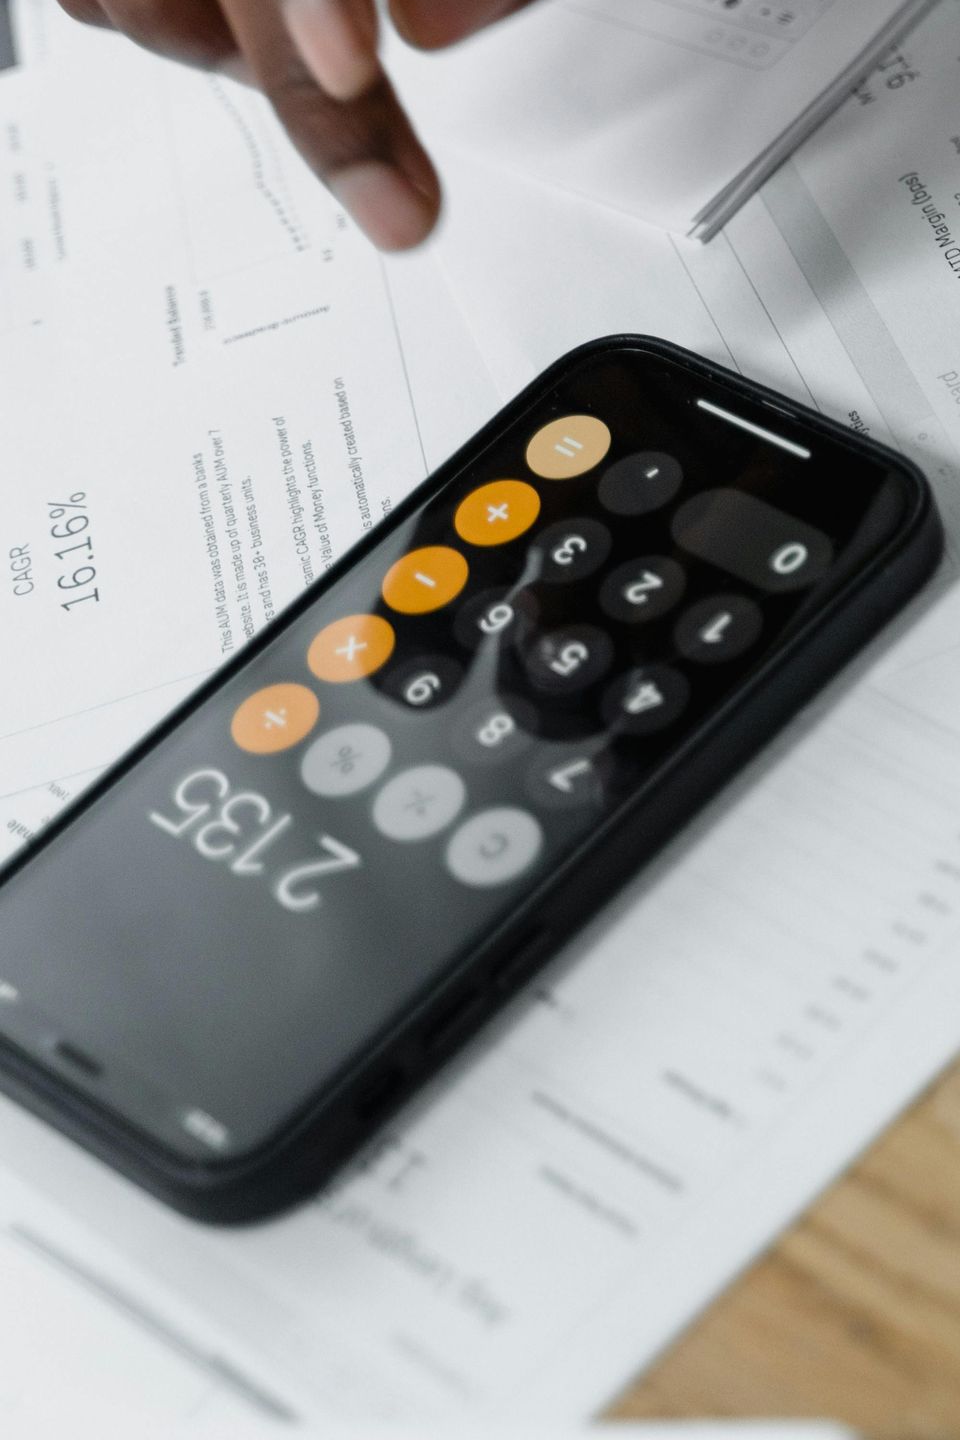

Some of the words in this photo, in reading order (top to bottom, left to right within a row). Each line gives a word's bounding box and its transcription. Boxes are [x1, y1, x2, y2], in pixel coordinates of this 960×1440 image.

[898, 172, 932, 205] (bps)
[920, 203, 955, 248] Margin
[334, 377, 345, 389] on
[334, 391, 351, 420] based
[272, 416, 285, 426] of
[212, 437, 224, 456] over
[277, 428, 293, 457] power
[340, 420, 358, 455] created
[192, 453, 206, 482] banks
[213, 458, 228, 481] AUM
[281, 458, 294, 475] the
[302, 440, 318, 488] functions.
[199, 490, 211, 514] from
[241, 476, 254, 503] units.
[286, 475, 304, 524] highlights
[348, 457, 371, 520] automatically
[219, 484, 237, 526] quarterly
[312, 489, 325, 522] Money
[201, 515, 219, 558] obtained
[225, 528, 238, 538] of
[246, 504, 262, 549] business
[293, 524, 309, 554] CAGR
[314, 523, 328, 533] of
[48, 490, 101, 613] 16.16%
[230, 539, 242, 553] up
[320, 534, 332, 563] Value
[553, 535, 587, 565] 3
[771, 542, 807, 574] 0
[11, 543, 35, 597] CAGR
[211, 558, 222, 580] was
[231, 554, 245, 581] made
[258, 570, 268, 590] has
[214, 580, 226, 602] data
[258, 590, 273, 609] and
[624, 570, 663, 604] 2
[215, 604, 230, 628] AUM
[478, 603, 515, 635] 6
[702, 612, 732, 643] 1
[220, 630, 234, 653] This
[550, 642, 588, 676] 5
[405, 672, 441, 706] 9
[624, 681, 663, 714] 4
[477, 713, 515, 747] 8
[548, 760, 591, 793] 7
[480, 833, 510, 860] C
